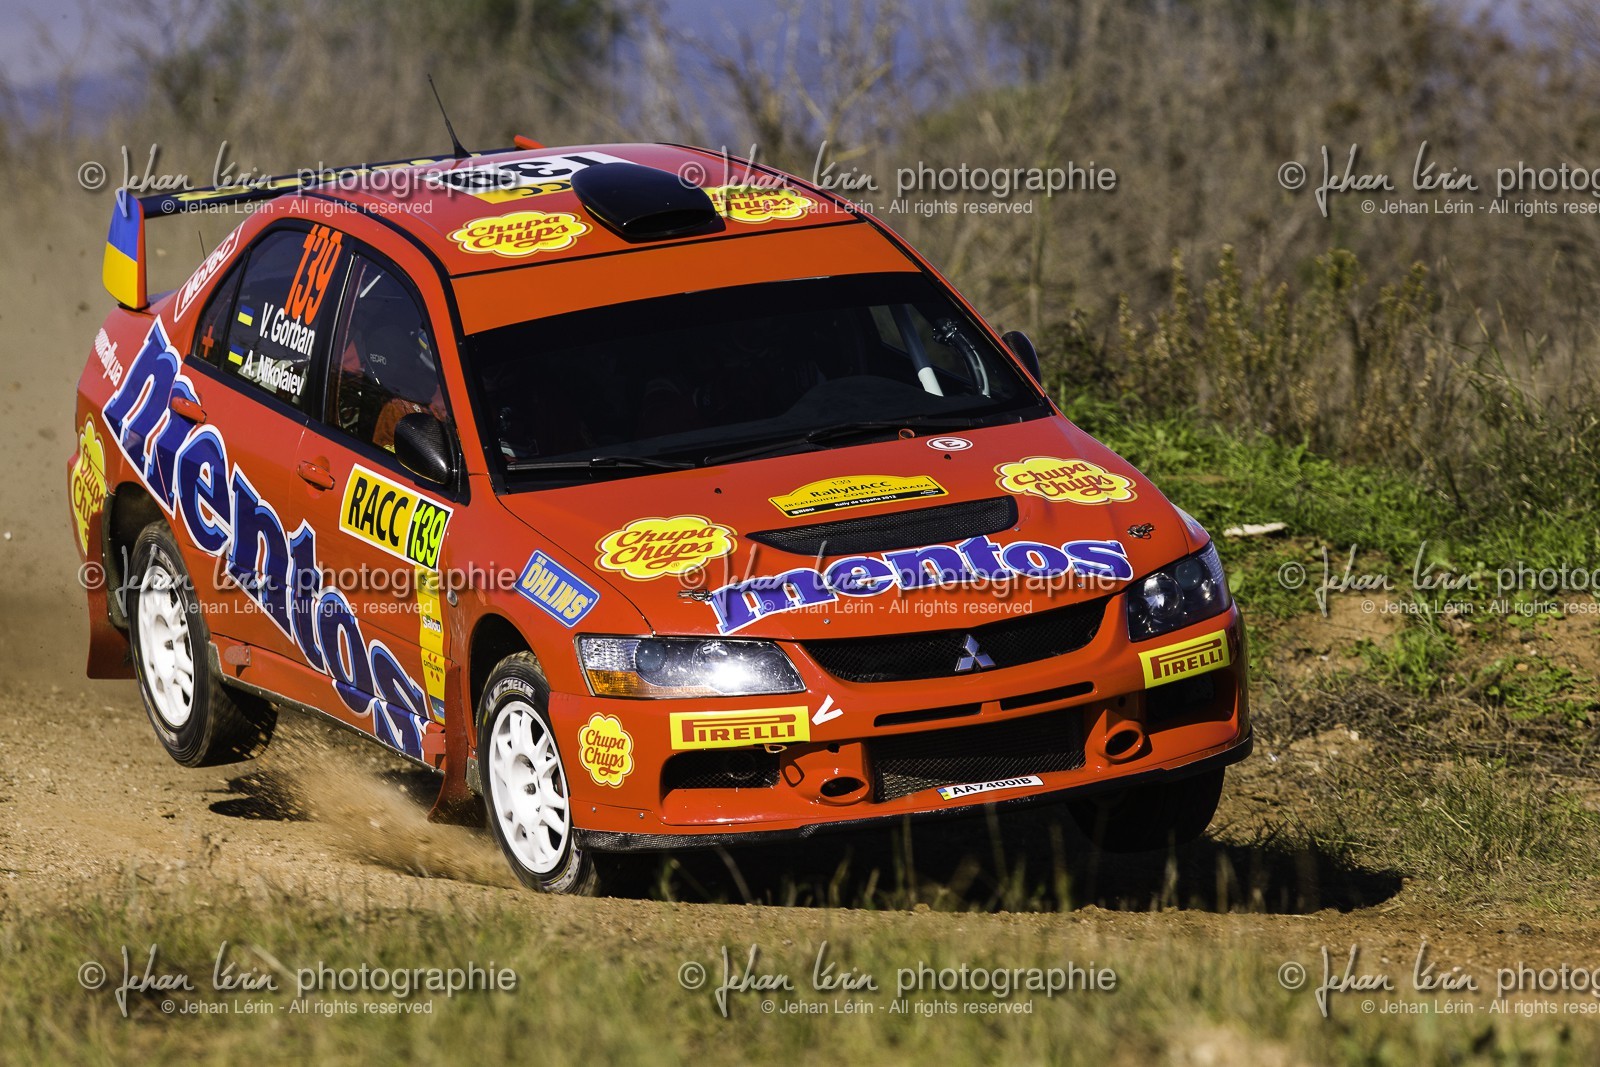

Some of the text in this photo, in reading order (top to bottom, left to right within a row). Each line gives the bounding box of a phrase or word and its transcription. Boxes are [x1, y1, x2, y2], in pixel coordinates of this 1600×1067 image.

[509, 179, 572, 197] CC
[711, 190, 780, 203] hupa
[466, 215, 560, 237] Chupa
[473, 223, 570, 249] Chups
[283, 224, 343, 325] 139
[259, 302, 316, 357] V. Gorban
[243, 350, 305, 396] A. Nikolaiev
[1012, 463, 1092, 485] Chupa
[1034, 473, 1116, 498] Chups
[809, 480, 892, 499] RallyRACC
[348, 476, 446, 568] RACC 139
[102, 313, 434, 762] mentos
[617, 526, 715, 548] Chupa
[610, 541, 714, 570] Chups
[521, 556, 590, 619] ÖHLINS
[703, 536, 1133, 635] mentos
[1150, 637, 1224, 680] PIRELLI
[585, 729, 626, 751] Chupa
[681, 714, 797, 742] PIRELLI
[584, 747, 626, 776] Chups
[952, 777, 1032, 795] AA7400IB
